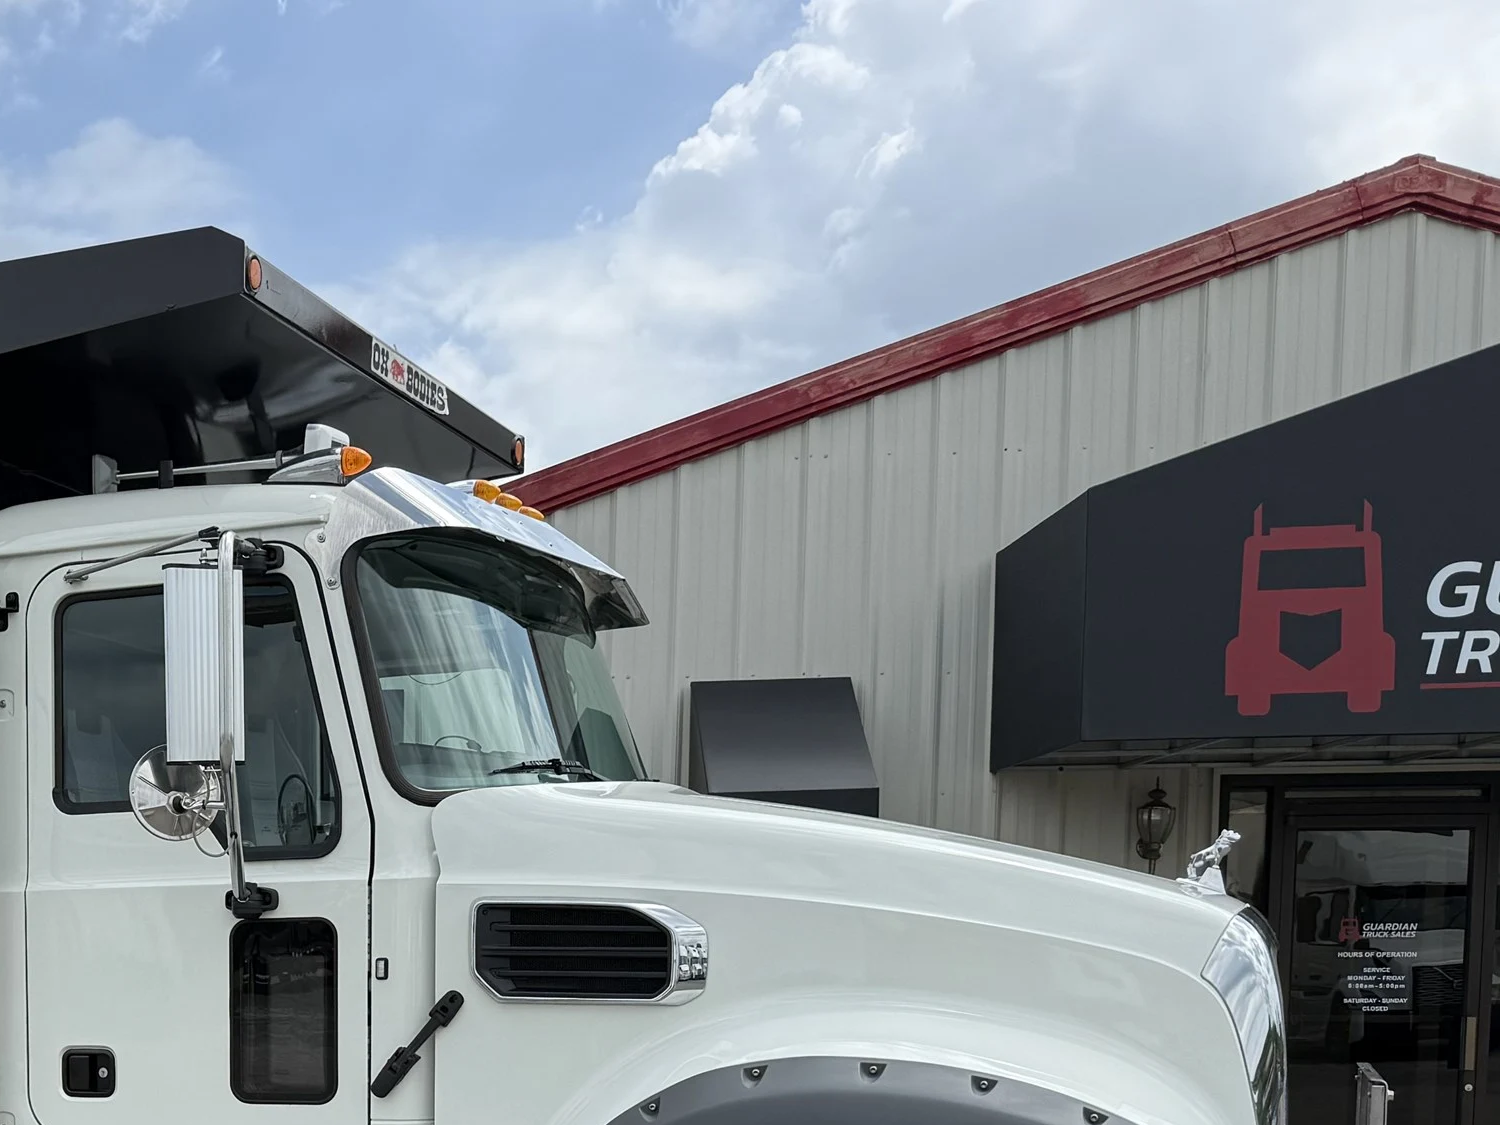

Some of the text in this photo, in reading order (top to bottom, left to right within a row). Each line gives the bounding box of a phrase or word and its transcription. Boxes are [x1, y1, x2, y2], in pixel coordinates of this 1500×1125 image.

[373, 342, 446, 412] OX BODIES
[1426, 560, 1500, 618] G
[1362, 922, 1418, 931] GUARDIAN
